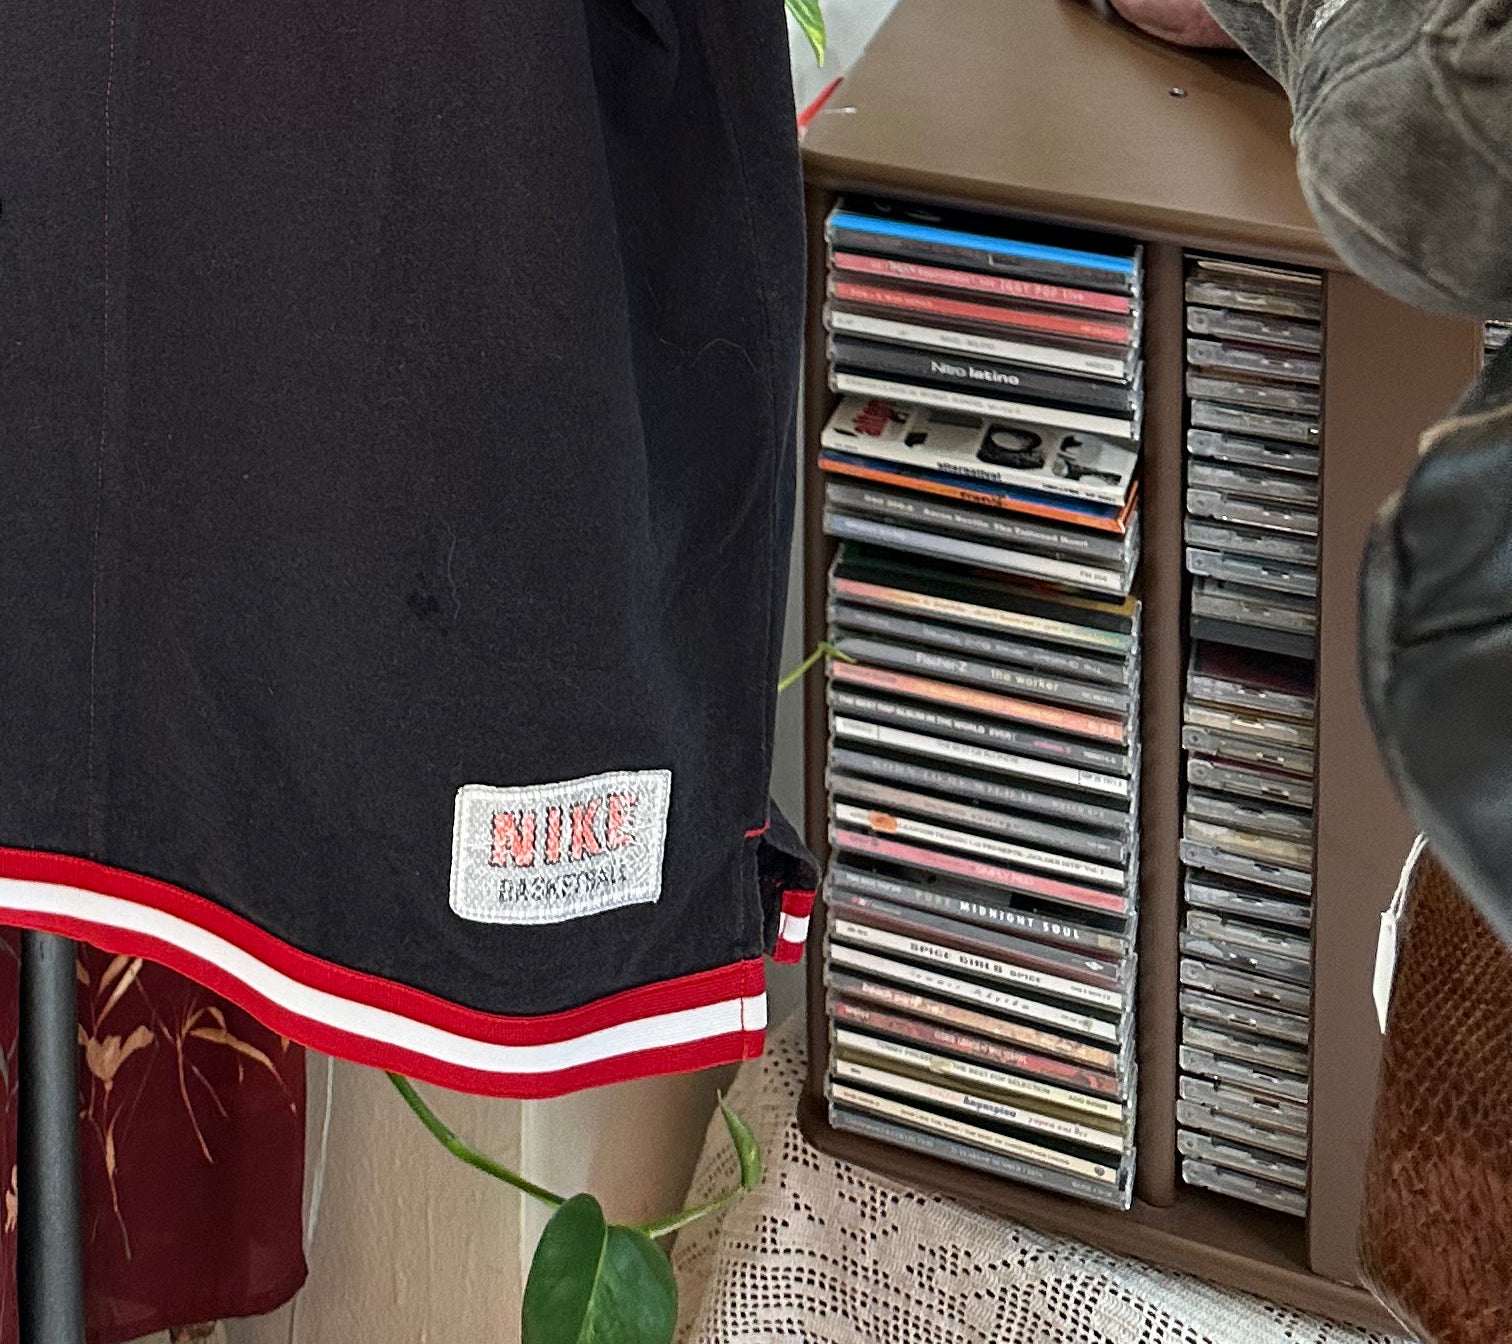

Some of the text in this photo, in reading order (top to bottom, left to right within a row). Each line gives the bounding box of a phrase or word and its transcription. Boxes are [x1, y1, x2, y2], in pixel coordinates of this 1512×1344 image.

[968, 366, 1020, 386] latino
[990, 667, 1060, 692] the worker
[489, 791, 638, 868] NIKE
[959, 900, 1036, 929] MIDNIGHT
[1042, 921, 1081, 940] SOUL
